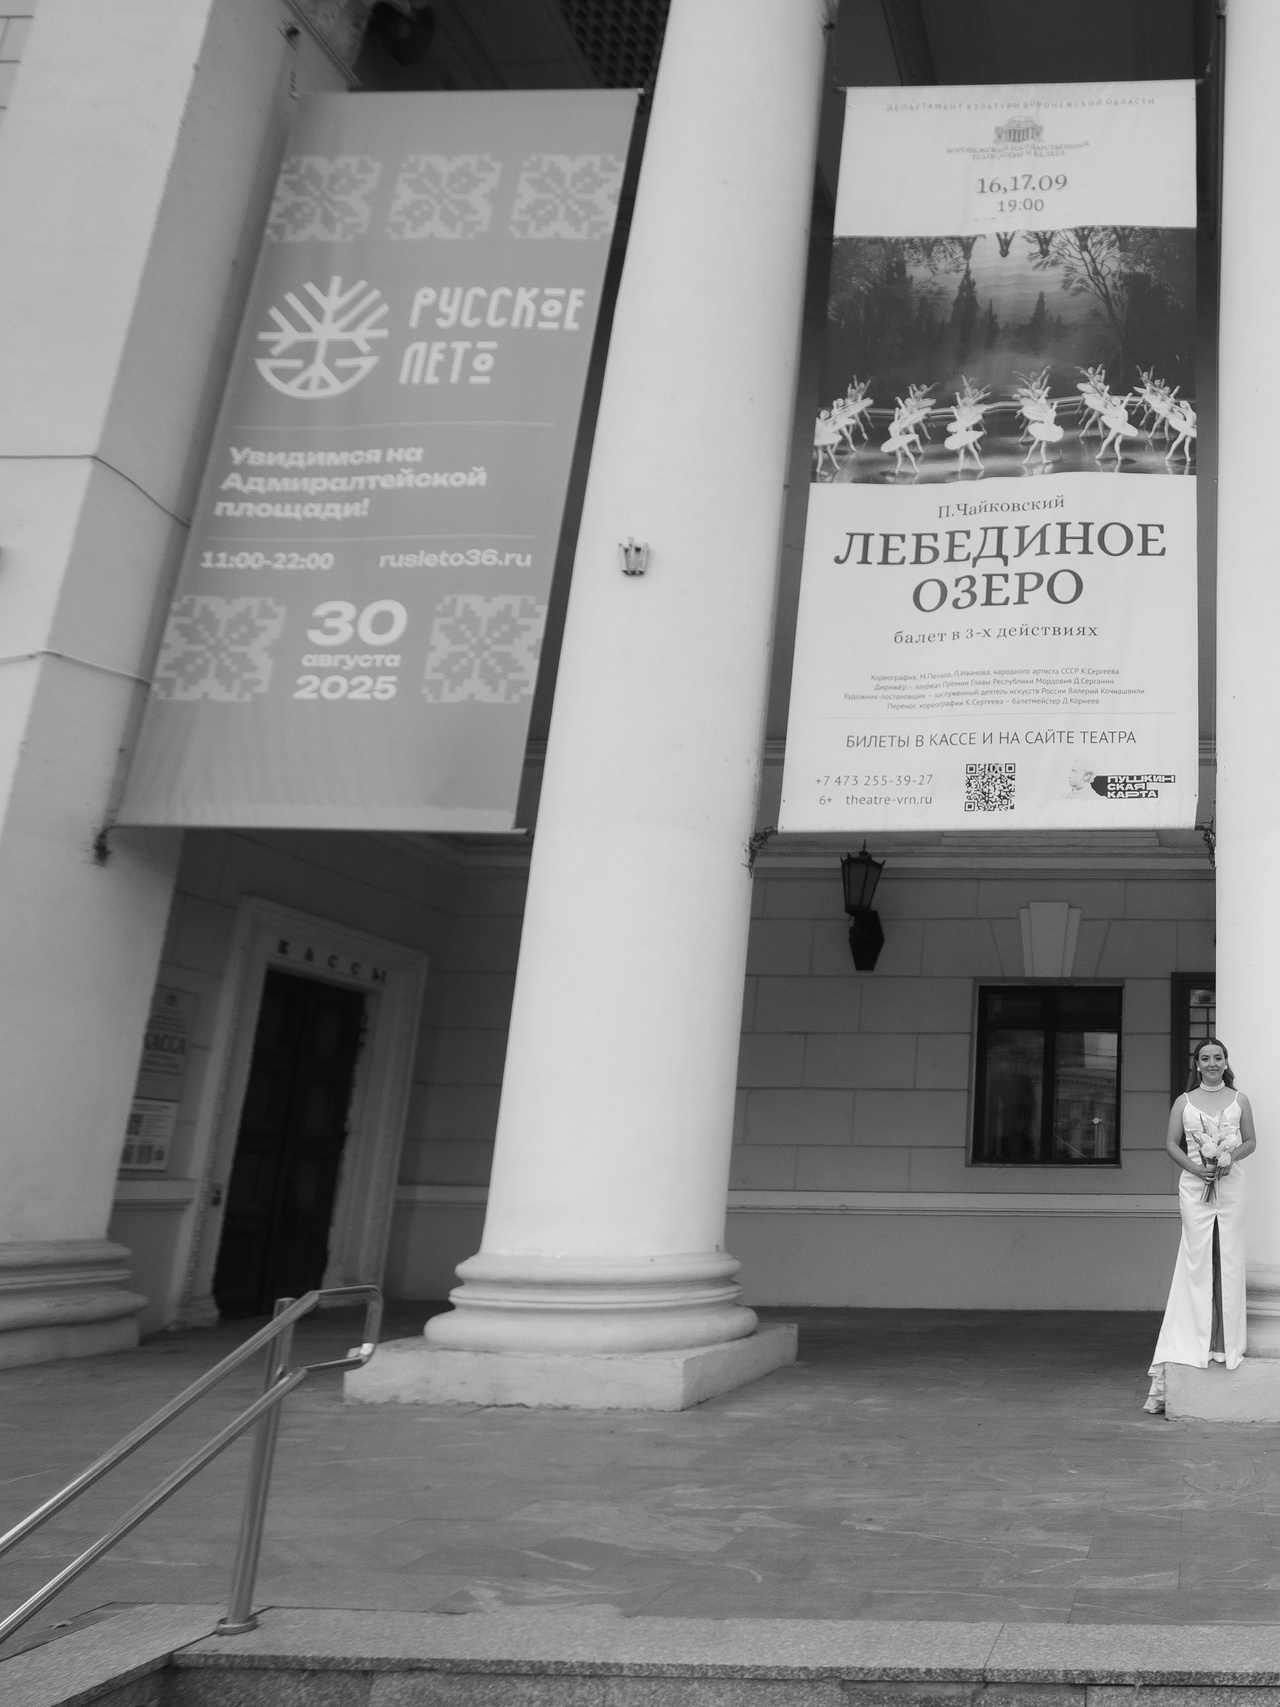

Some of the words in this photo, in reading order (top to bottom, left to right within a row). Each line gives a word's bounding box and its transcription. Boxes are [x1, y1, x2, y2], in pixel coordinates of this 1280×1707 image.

[977, 174, 1068, 194] 16,17.09
[998, 198, 1044, 212] 19:00
[409, 287, 585, 330] РУССКОЕ
[399, 341, 498, 384] ЛЕТО
[231, 448, 383, 468] Увидимся
[386, 445, 424, 463] на
[222, 466, 488, 495] Адмиралтейской
[216, 497, 370, 521] площади!
[938, 495, 1064, 518] П.Чайковский
[834, 522, 1166, 568] ЛЕБЕДИНОЕ
[201, 551, 335, 571] 11:00-22:00
[379, 549, 532, 569] rusleto36.ru
[913, 569, 1083, 612] ОЗЕРО
[307, 600, 407, 646] 30
[894, 629, 947, 644] балет
[952, 631, 960, 641] в
[965, 628, 991, 639] 3-х
[997, 623, 1098, 639] действиях
[301, 651, 401, 672] августа
[293, 675, 397, 700] 2025
[1068, 687, 1098, 695] Валерий
[846, 734, 910, 748] БИЛЕТЫ
[915, 734, 924, 748] В
[929, 732, 977, 746] КАССЕ
[982, 731, 993, 745] И
[999, 731, 1020, 745] НА
[1024, 728, 1075, 745] САЙТЕ
[1080, 730, 1137, 744] ТЕАТРА
[814, 775, 831, 786] +7
[834, 774, 859, 786] 473
[863, 773, 934, 786] 255-39-27
[1106, 774, 1176, 783] ПУШКИН
[1106, 782, 1147, 790] СКАЯ
[819, 795, 833, 805] 6+
[845, 794, 933, 806] theatre-vrn.ru
[1106, 790, 1158, 798] КАРТА
[277, 938, 386, 983] КАССЫ
